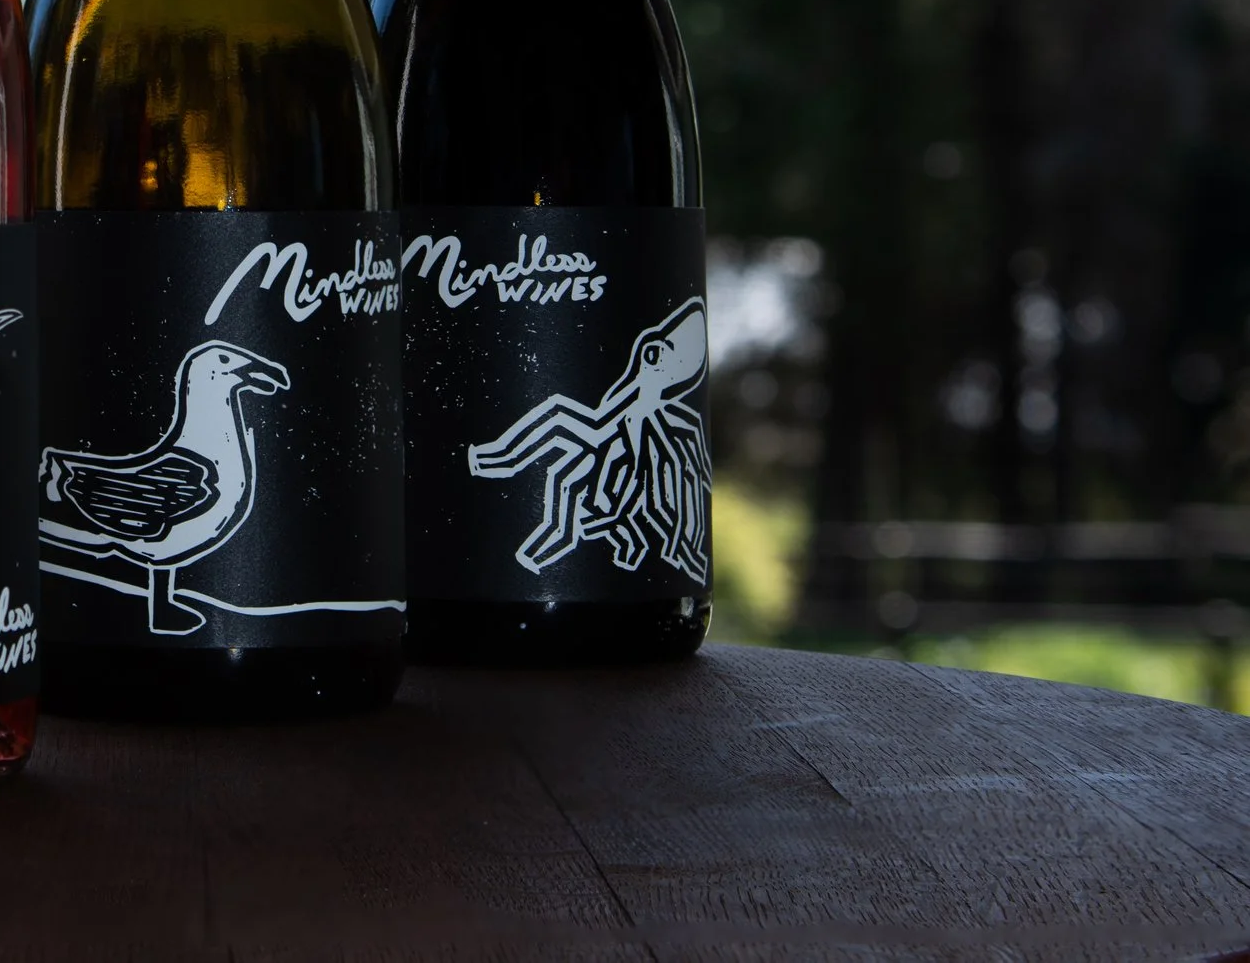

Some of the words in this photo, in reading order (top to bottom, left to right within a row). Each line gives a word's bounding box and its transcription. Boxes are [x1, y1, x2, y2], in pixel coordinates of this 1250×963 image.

[204, 239, 396, 326] Mindless
[401, 234, 597, 308] Mindless
[497, 276, 607, 305] WINES
[340, 283, 399, 316] WINES
